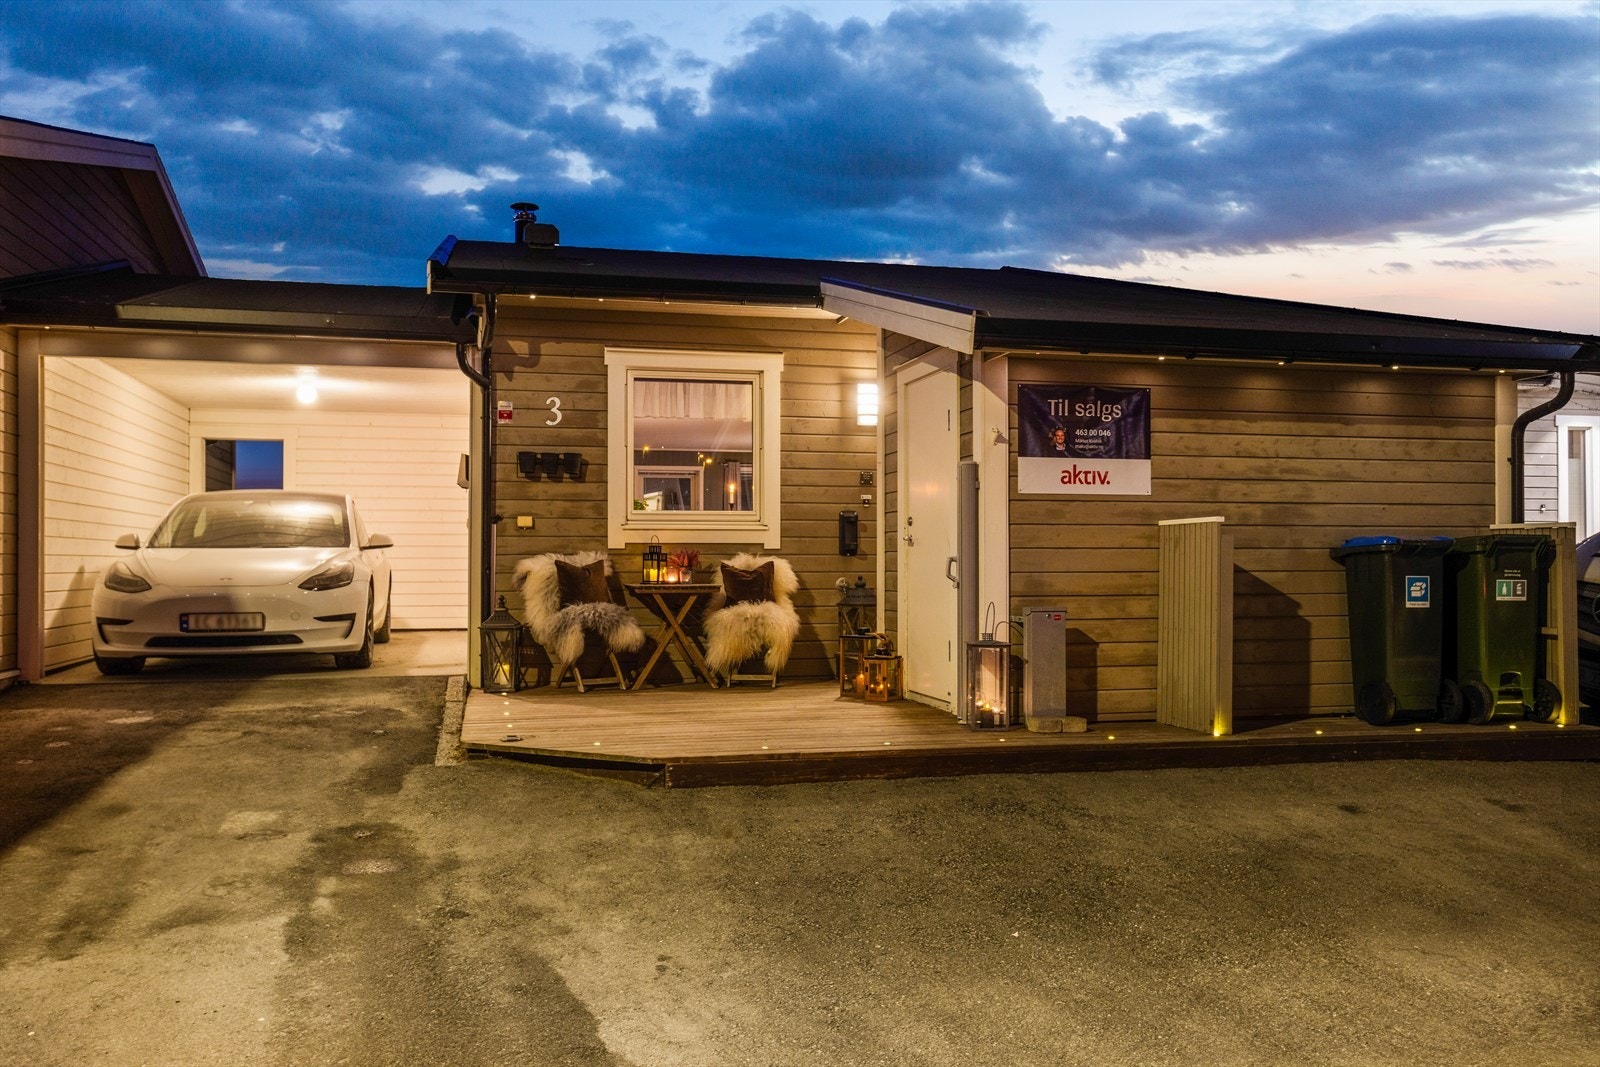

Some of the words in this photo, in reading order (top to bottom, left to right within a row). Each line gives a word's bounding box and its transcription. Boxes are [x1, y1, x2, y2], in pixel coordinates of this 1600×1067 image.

[545, 396, 563, 426] 3
[1047, 398, 1069, 416] Til
[1075, 400, 1122, 422] salgs
[1075, 428, 1088, 436] 463
[1089, 429, 1098, 437] 00
[1098, 429, 1112, 437] 046
